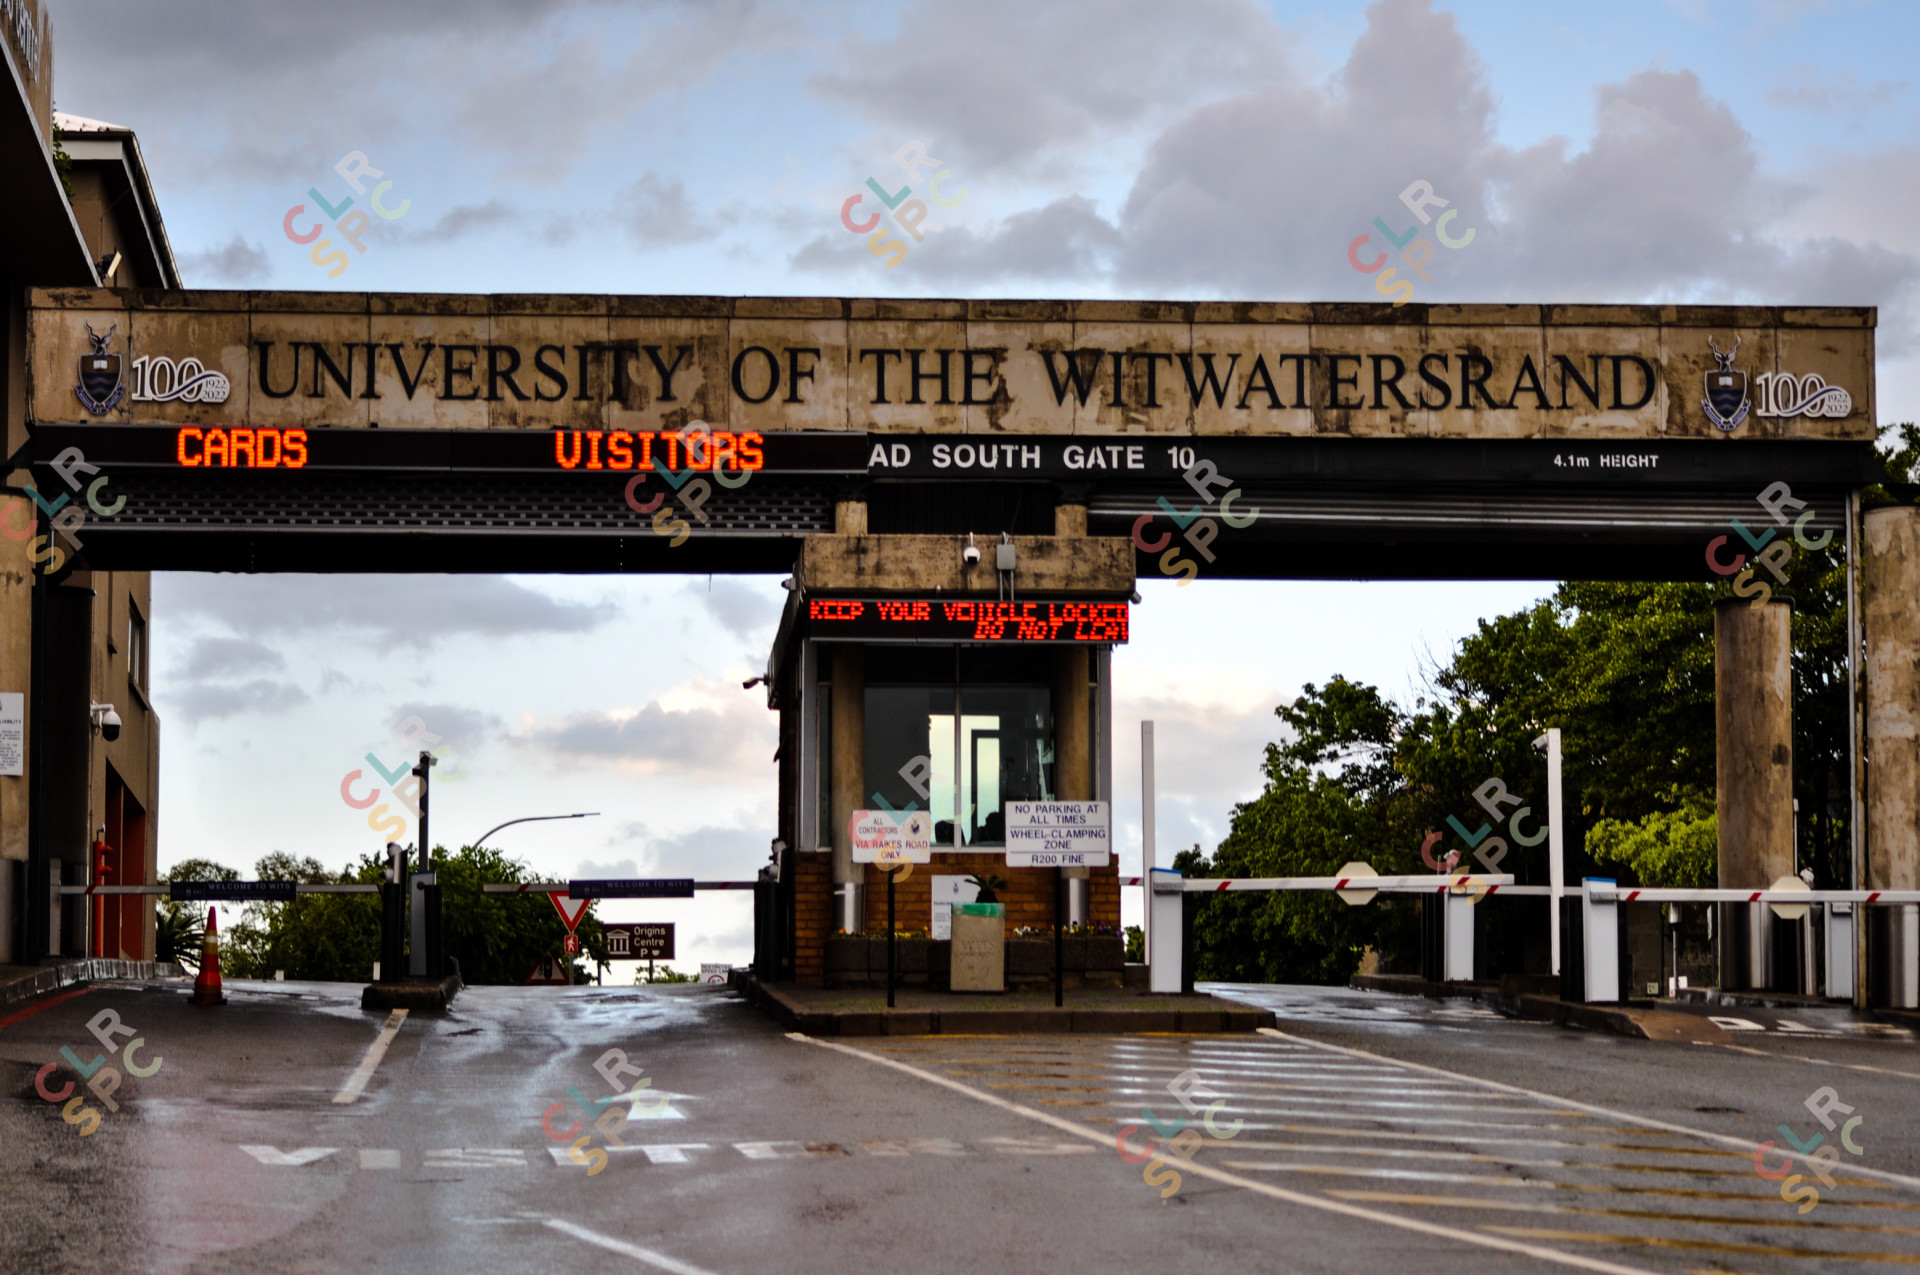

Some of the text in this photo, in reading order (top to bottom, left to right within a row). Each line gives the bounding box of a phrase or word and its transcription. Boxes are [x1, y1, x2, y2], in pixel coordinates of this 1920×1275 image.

[132, 355, 204, 402] 100
[255, 340, 1656, 412] UNIVERSITY OF THE WITWATERSRAND
[205, 380, 226, 389] 1922
[203, 390, 226, 400] 2022
[1756, 372, 1826, 417] 100
[1828, 393, 1848, 403] 1922
[1826, 404, 1848, 414] 2022
[177, 427, 308, 469] CARDS
[556, 430, 764, 471] VISITORS
[932, 444, 1041, 469] SOUTH
[1063, 446, 1145, 469] GATE
[1168, 447, 1195, 469] 10
[1553, 454, 1659, 468] 4.1m HEIGHT
[810, 600, 865, 620] KEEP
[877, 601, 931, 621] YOUR
[1049, 603, 1129, 622] LOCKED
[974, 621, 1005, 639] DO
[1017, 621, 1063, 640] NOT
[1015, 804, 1099, 814] NO PARKING AT
[873, 817, 883, 825] ALL
[1030, 815, 1086, 824] ALL TIMES
[858, 826, 898, 834] CONTRACTORS
[1010, 829, 1106, 839] WHEEL-CLAMPING
[856, 840, 869, 849] VIA
[905, 840, 928, 849] ROAD
[1044, 840, 1072, 849] ZONE
[881, 850, 901, 859] ONLY
[1031, 854, 1084, 864] R200 FINE
[633, 926, 666, 937] Origins
[634, 937, 665, 947] Centre
